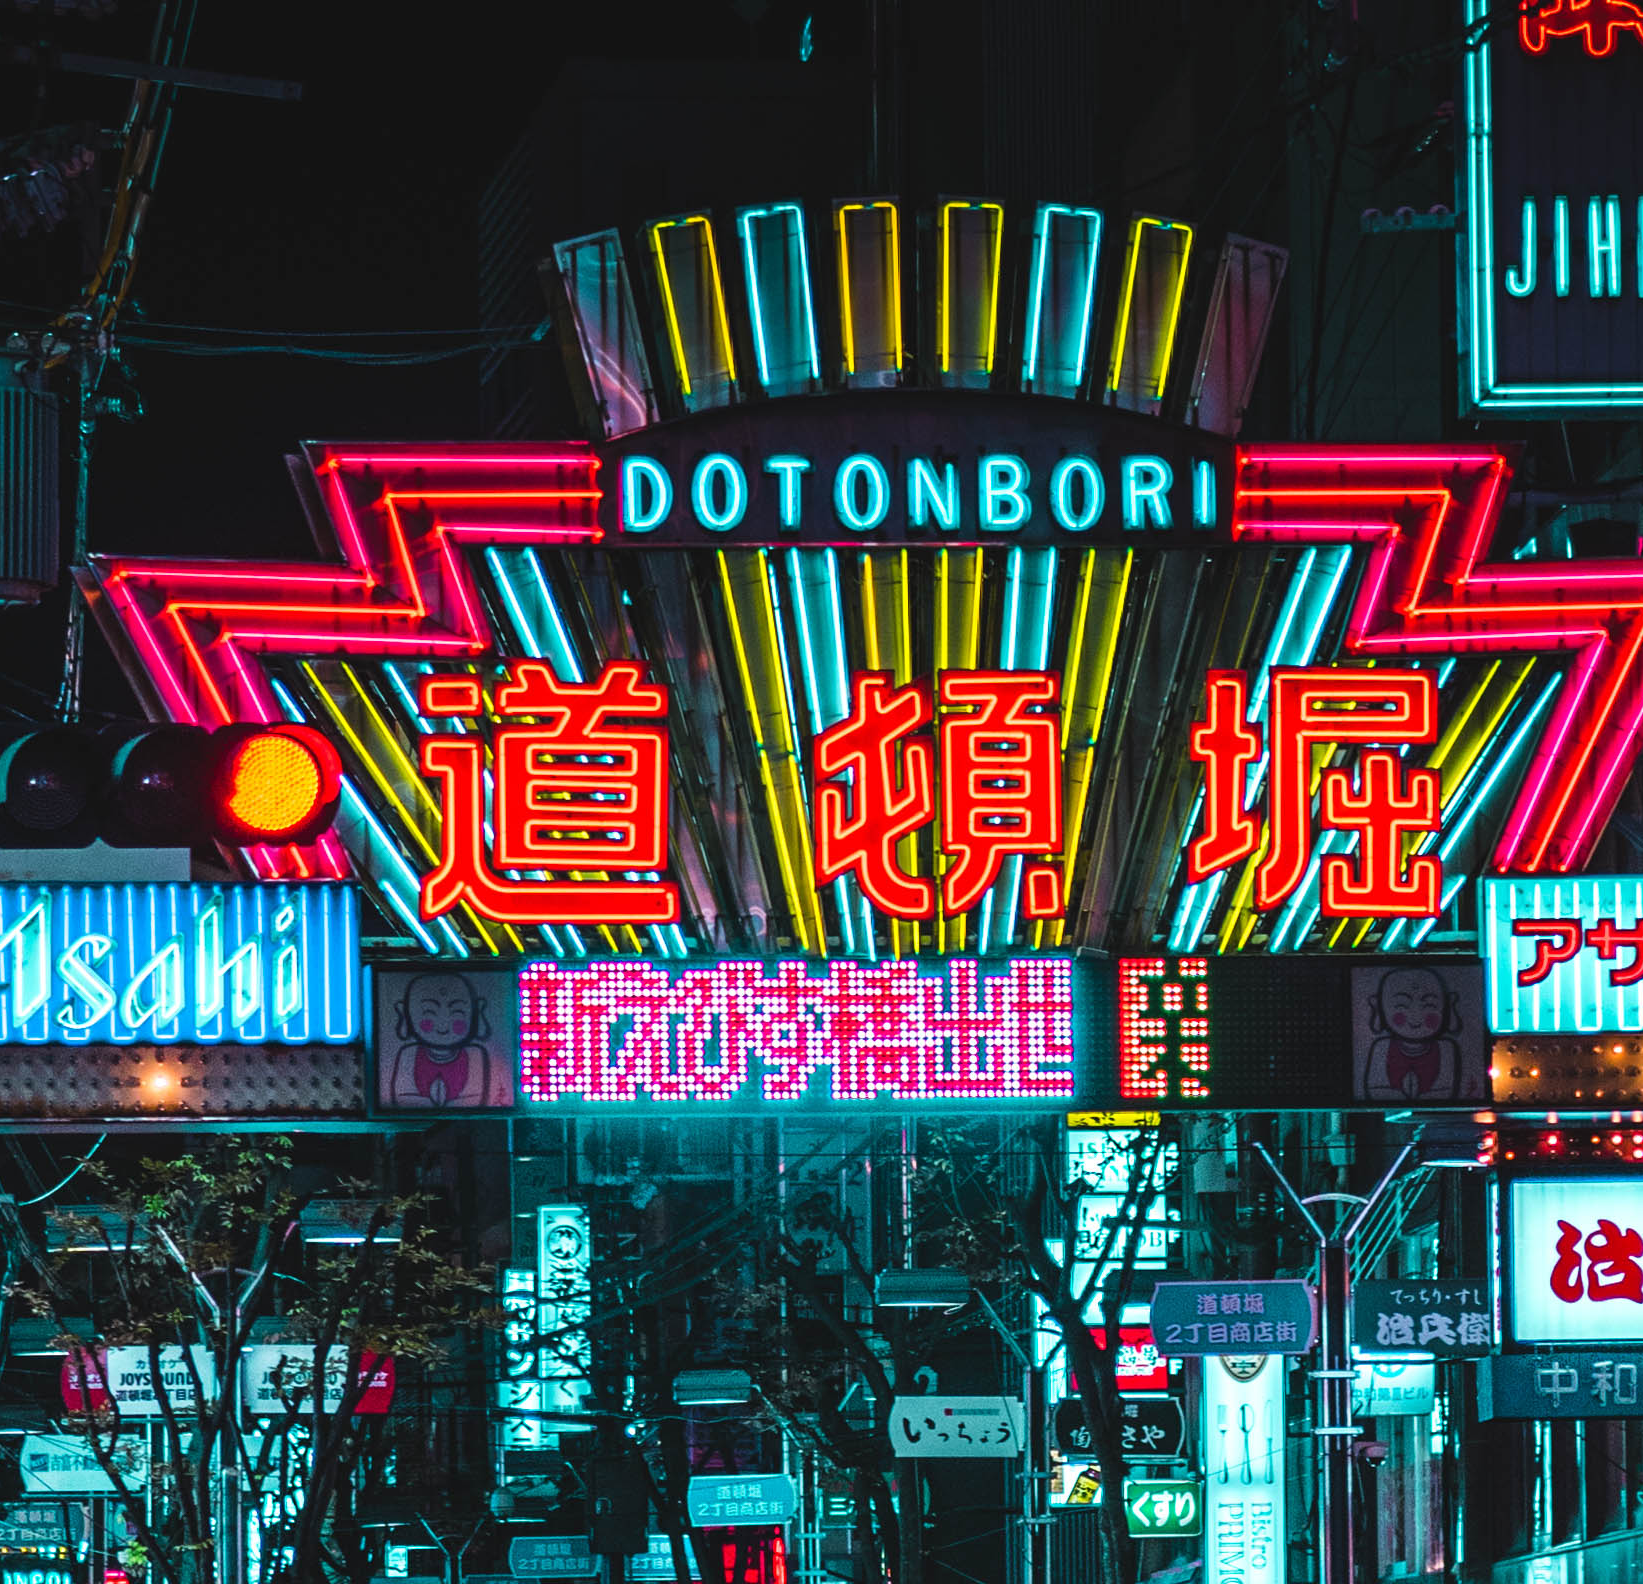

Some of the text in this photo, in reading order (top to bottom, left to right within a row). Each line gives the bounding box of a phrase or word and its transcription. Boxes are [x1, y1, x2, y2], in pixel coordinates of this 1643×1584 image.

[620, 453, 1220, 535] DOTONBORI
[419, 660, 1444, 924] 道頓堀
[1196, 1293, 1265, 1315] 道頓堀
[1165, 1322, 1298, 1344] 2丁目商店街
[119, 1373, 195, 1386] JOYSUND
[904, 1417, 1011, 1445] いっちょう
[1132, 1491, 1196, 1527] くすり
[1252, 1502, 1273, 1570] Bistro
